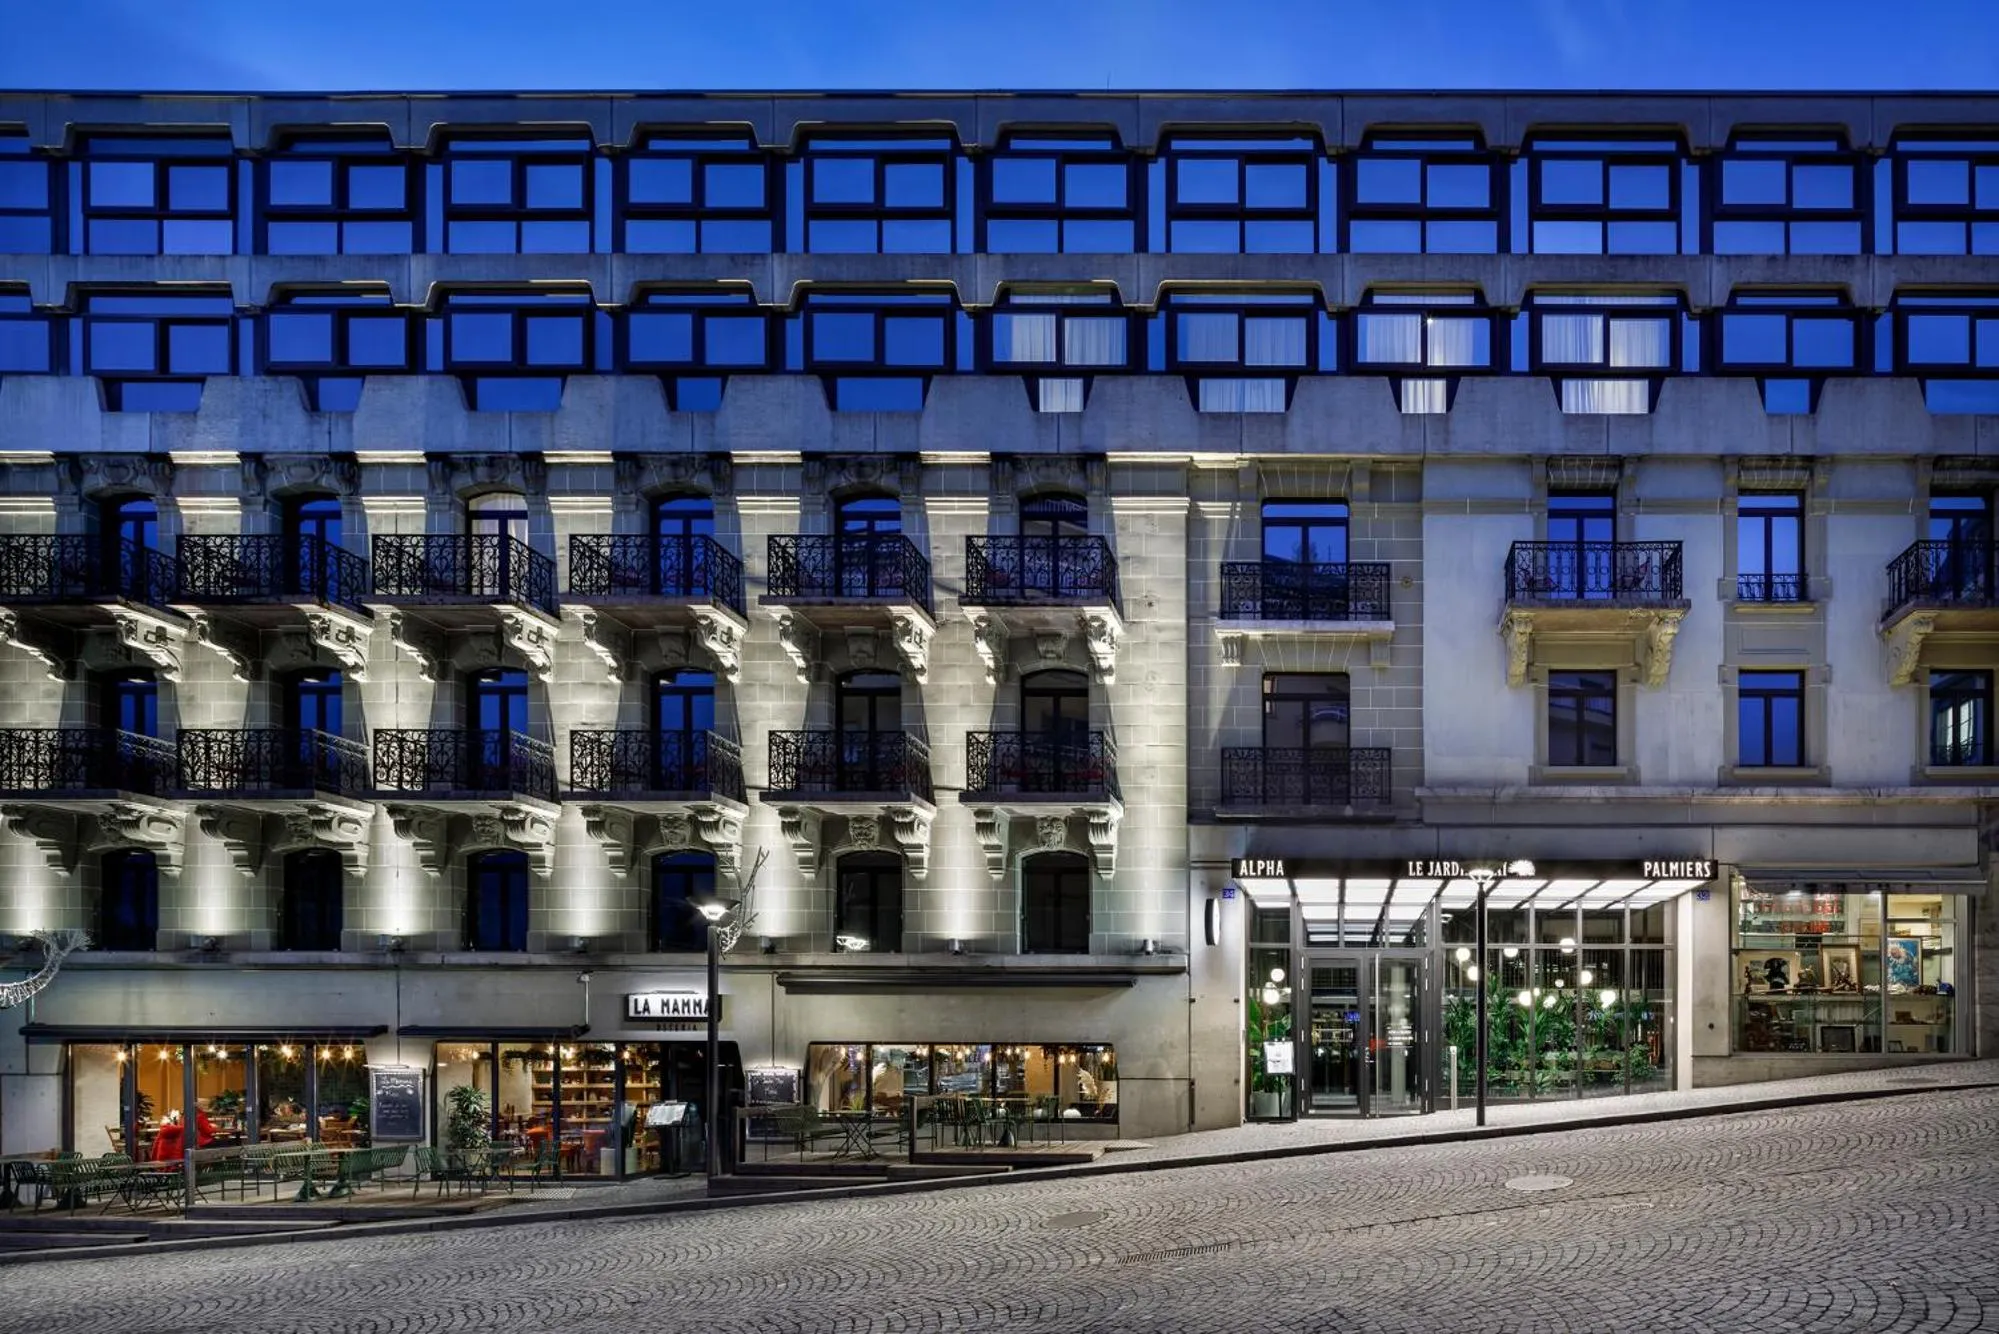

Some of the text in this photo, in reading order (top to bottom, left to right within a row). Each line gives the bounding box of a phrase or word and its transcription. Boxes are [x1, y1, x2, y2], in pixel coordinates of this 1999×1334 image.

[1240, 860, 1285, 876] ALPHA
[1408, 861, 1424, 876] LE
[1428, 861, 1472, 876] JARDI
[1643, 861, 1711, 878] PALMIERS
[633, 998, 651, 1015] LA
